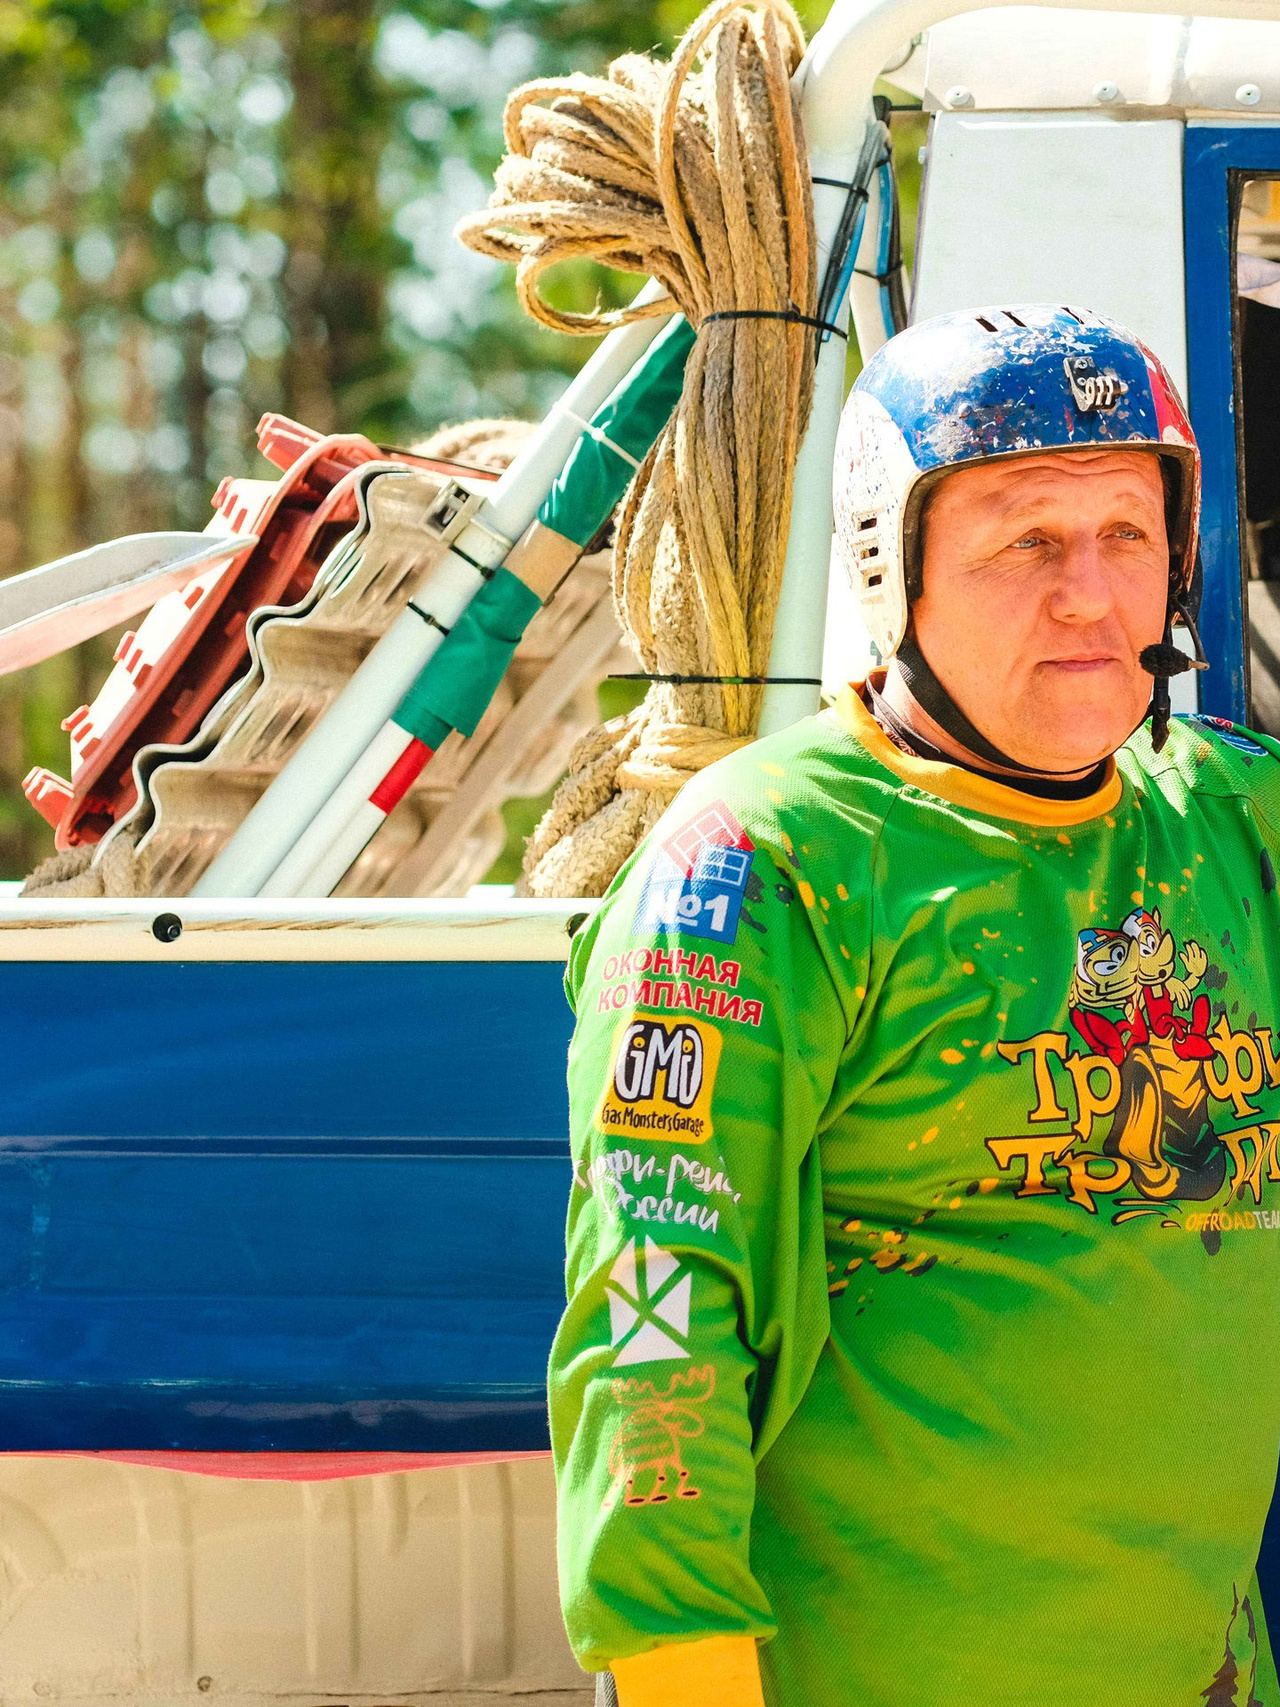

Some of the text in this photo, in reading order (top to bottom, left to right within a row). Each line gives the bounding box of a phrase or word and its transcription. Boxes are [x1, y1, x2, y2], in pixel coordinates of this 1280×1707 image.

[644, 888, 730, 932] №1
[602, 947, 741, 988] ОКОННАЯ
[597, 979, 763, 1027] КОМПАНИЯ
